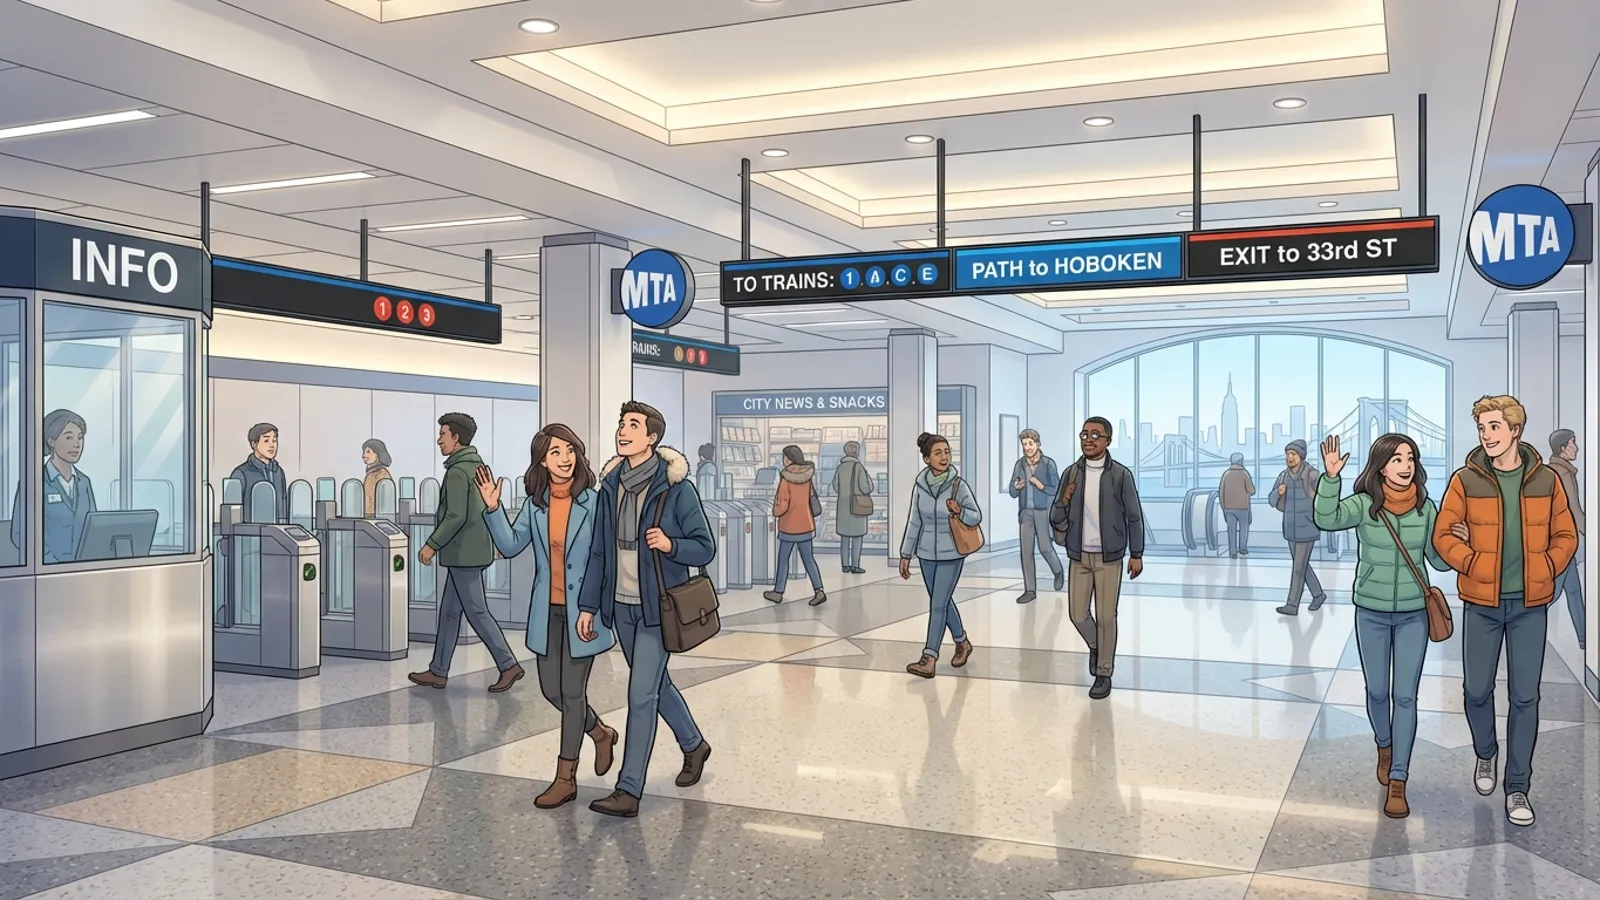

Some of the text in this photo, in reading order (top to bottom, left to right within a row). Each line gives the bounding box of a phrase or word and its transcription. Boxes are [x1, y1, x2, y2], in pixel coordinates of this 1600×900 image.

[1221, 238, 1397, 265] EXIT to 33rd ST
[1469, 210, 1561, 266] MTA
[72, 237, 178, 294] INFO
[973, 252, 1161, 279] PATH to HOBOKEN
[621, 269, 676, 311] MTA
[733, 276, 757, 293] TO
[762, 271, 835, 291] TRAINS:
[744, 396, 884, 409] CITY NEWS & SNACKS
